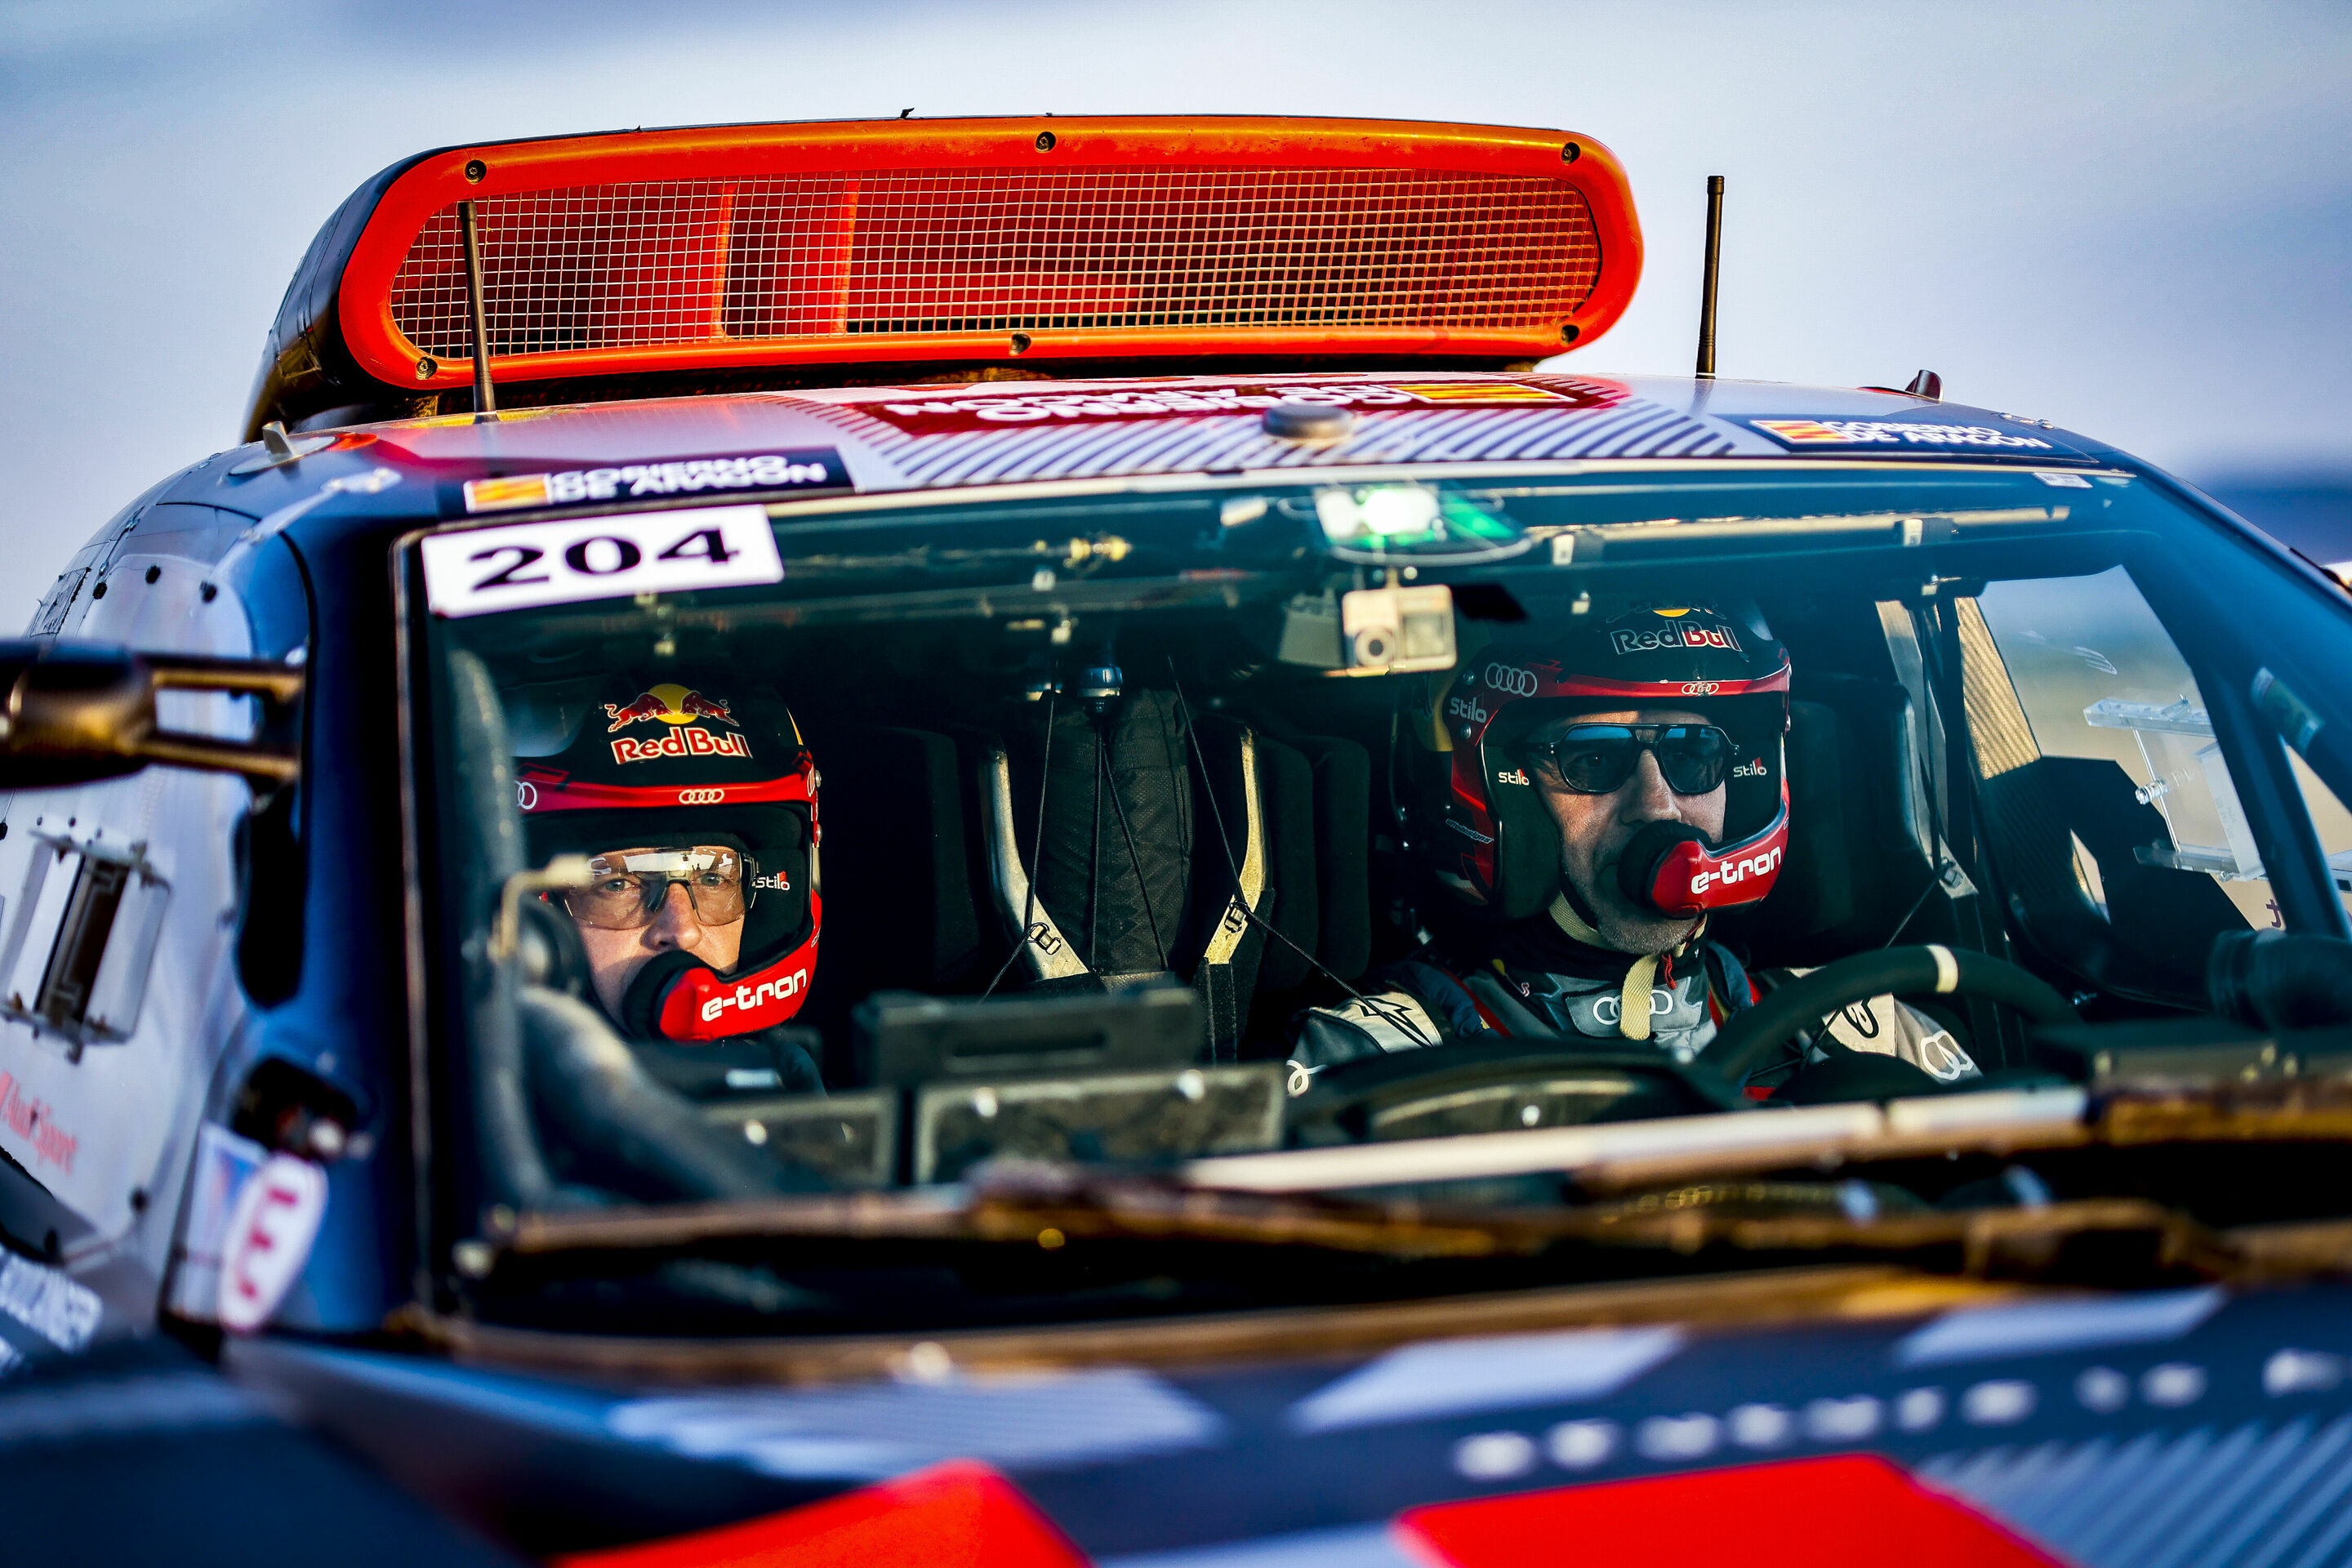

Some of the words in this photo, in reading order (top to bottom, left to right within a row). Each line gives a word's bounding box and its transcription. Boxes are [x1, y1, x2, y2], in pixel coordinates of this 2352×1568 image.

[1841, 430, 1900, 442] DE
[469, 528, 740, 590] 204
[1610, 621, 1684, 654] Red
[1678, 621, 1743, 651] Bull
[1450, 697, 1486, 723] stilo
[610, 727, 686, 764] Red
[684, 727, 753, 759] Bull
[1499, 769, 1530, 786] stilo
[1734, 760, 1766, 777] stilo
[755, 872, 791, 890] stilo
[1691, 846, 1781, 893] e-tron
[702, 969, 807, 1022] e-tron
